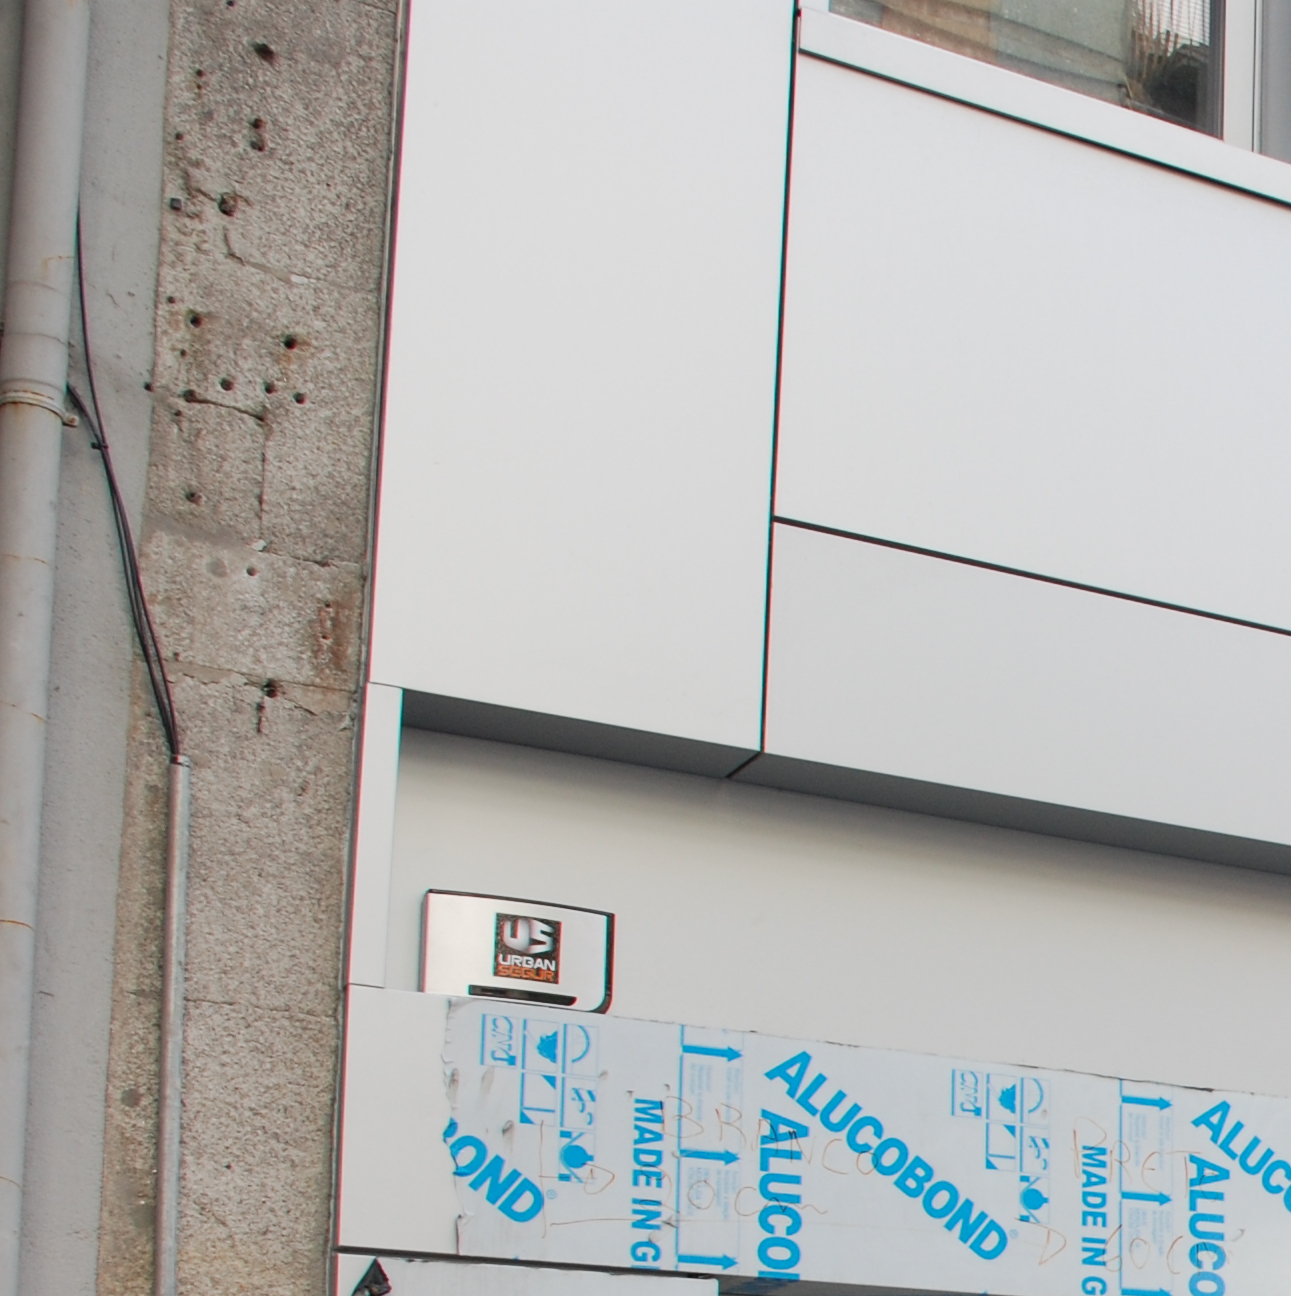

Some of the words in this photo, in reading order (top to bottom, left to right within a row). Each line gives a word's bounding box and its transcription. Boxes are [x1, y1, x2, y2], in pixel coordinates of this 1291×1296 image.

[502, 918, 553, 954] US
[497, 965, 554, 982] SEGUR
[499, 953, 556, 972] URBAN
[631, 1098, 664, 1188] MADE
[764, 1050, 1009, 1261] ALUCOBOND
[1081, 1145, 1108, 1228] MADE
[631, 1198, 662, 1231] IN
[1081, 1237, 1107, 1267] IN
